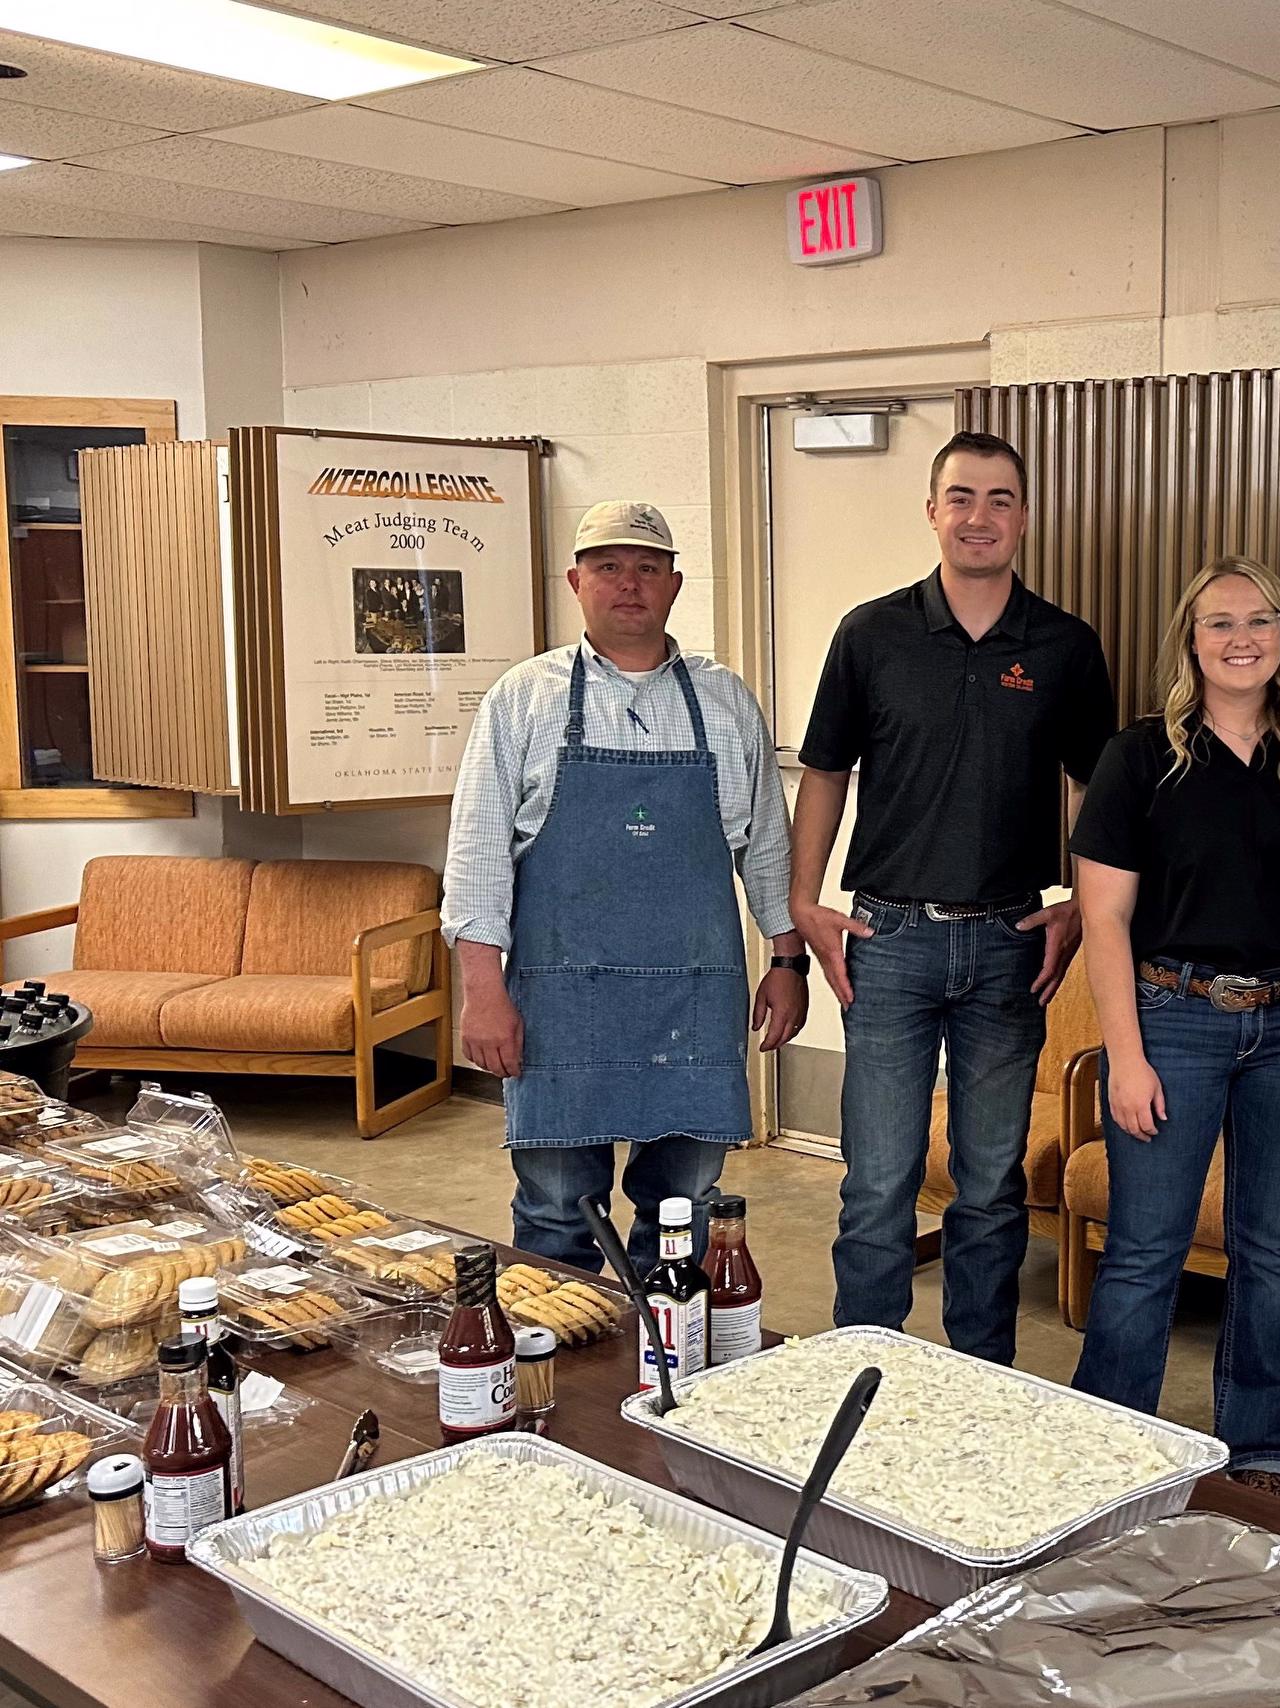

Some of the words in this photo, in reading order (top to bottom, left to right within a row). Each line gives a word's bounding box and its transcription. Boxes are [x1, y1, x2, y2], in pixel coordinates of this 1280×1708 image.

[799, 182, 857, 256] EXIT
[307, 467, 505, 504] INTERCOLLEGIATE
[323, 516, 370, 548] Meat
[374, 511, 438, 533] Judging
[442, 517, 485, 553] Team
[389, 534, 426, 550] 2000
[334, 768, 397, 778] OKLAHOMA
[402, 766, 433, 776] STATE
